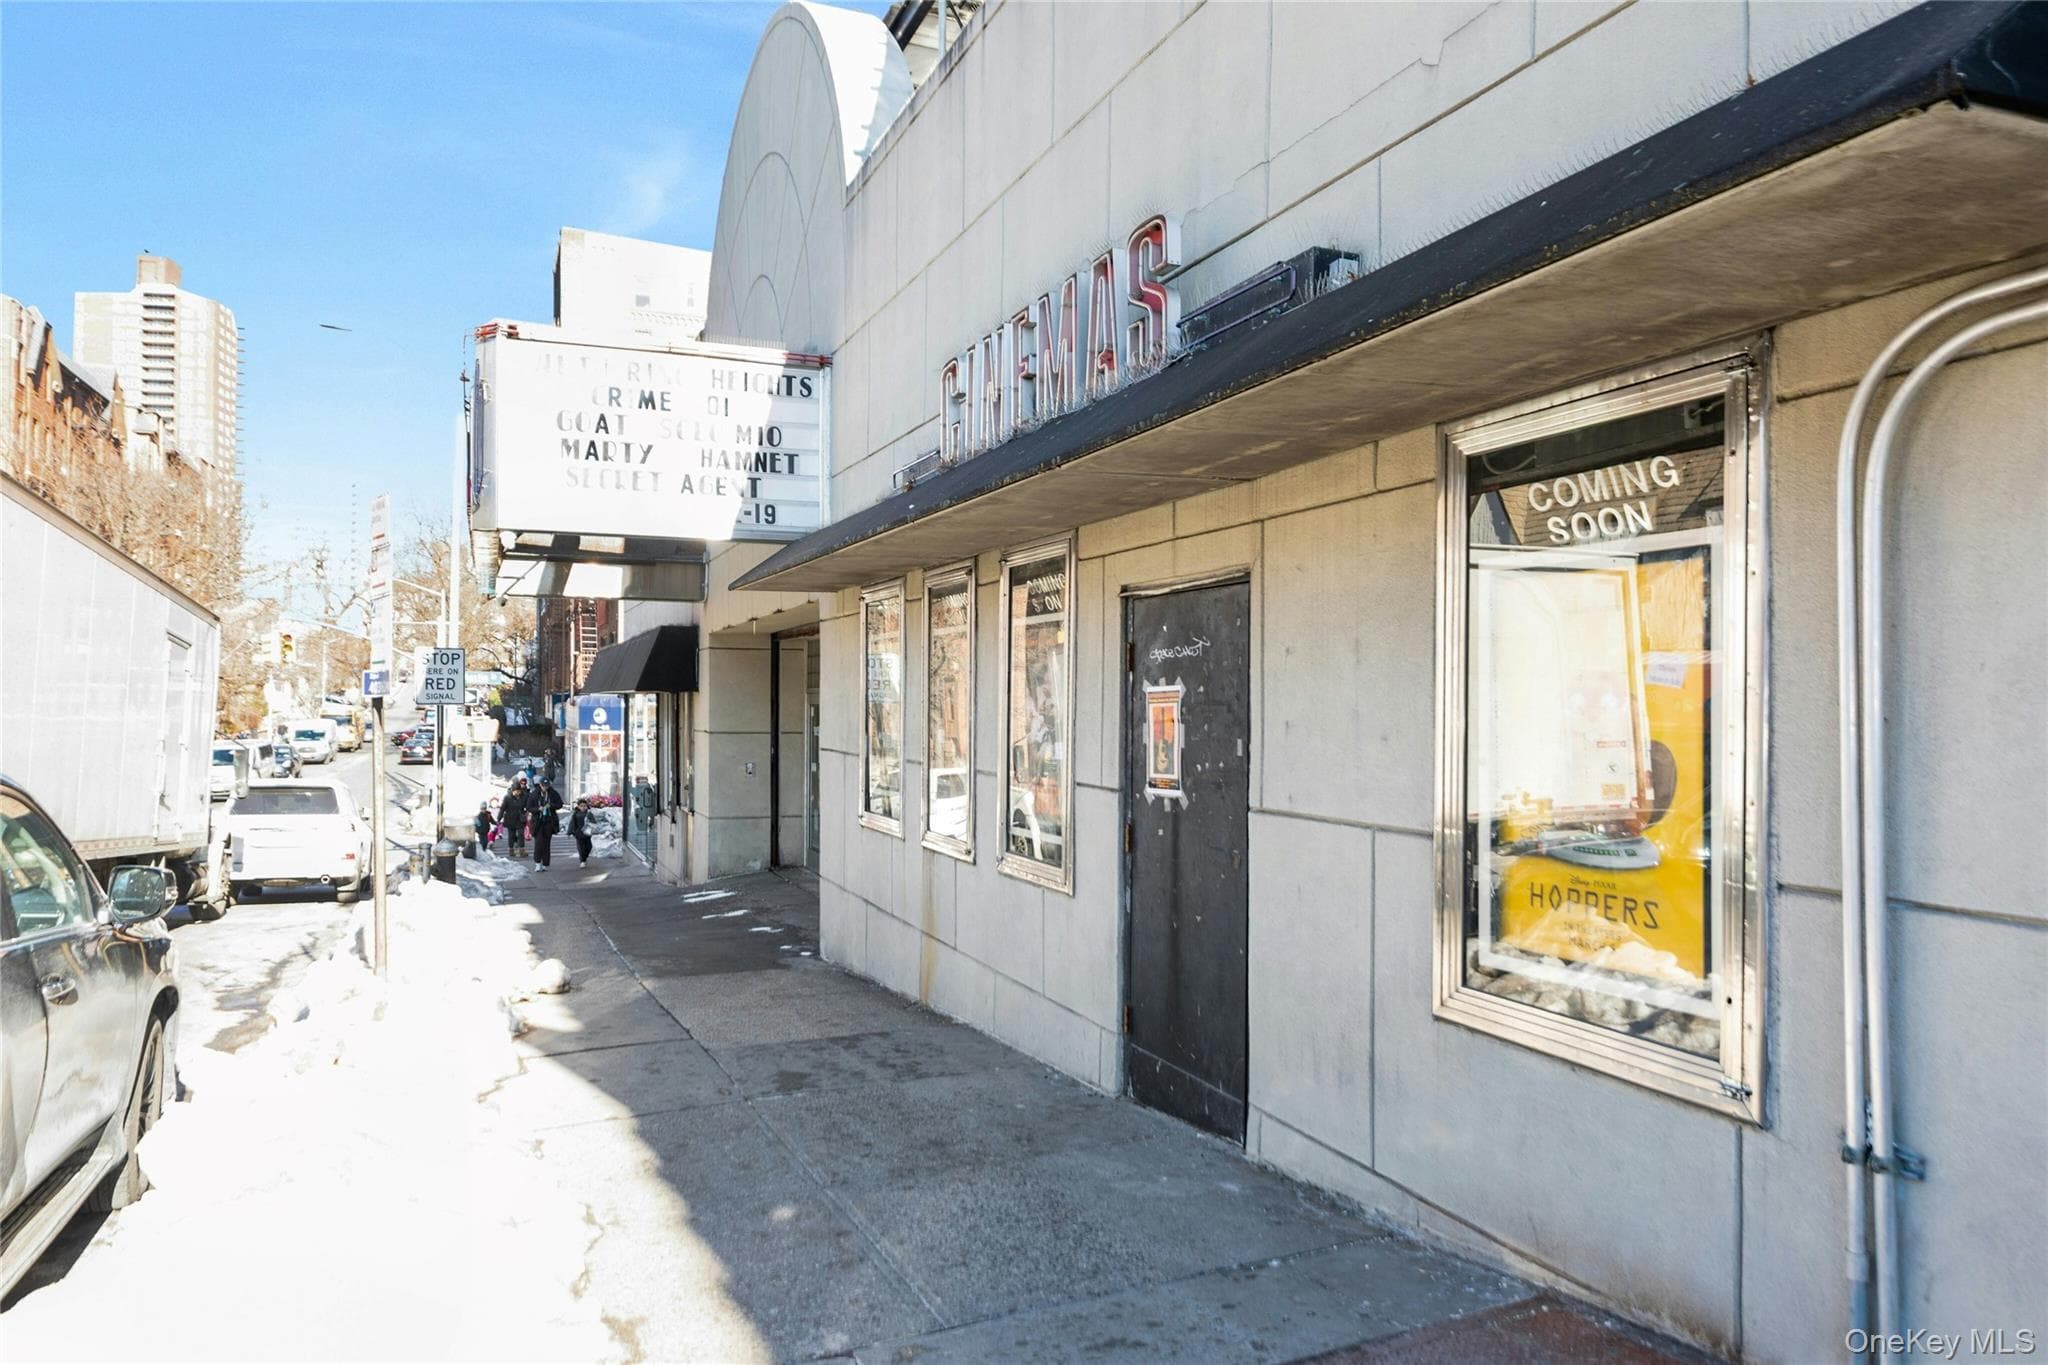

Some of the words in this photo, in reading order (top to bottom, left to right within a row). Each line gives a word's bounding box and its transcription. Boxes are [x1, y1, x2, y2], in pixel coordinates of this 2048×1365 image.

[940, 215, 1181, 464] CINEMAS
[557, 410, 627, 435] GOAT
[736, 424, 781, 447] MIO
[561, 439, 653, 464] MARTY
[701, 449, 798, 474] HAMNET
[1528, 455, 1680, 512] COMING
[1547, 501, 1654, 546] SOON
[1032, 595, 1062, 612] SON
[425, 678, 456, 690] RED
[1530, 882, 1659, 929] HOPPERS
